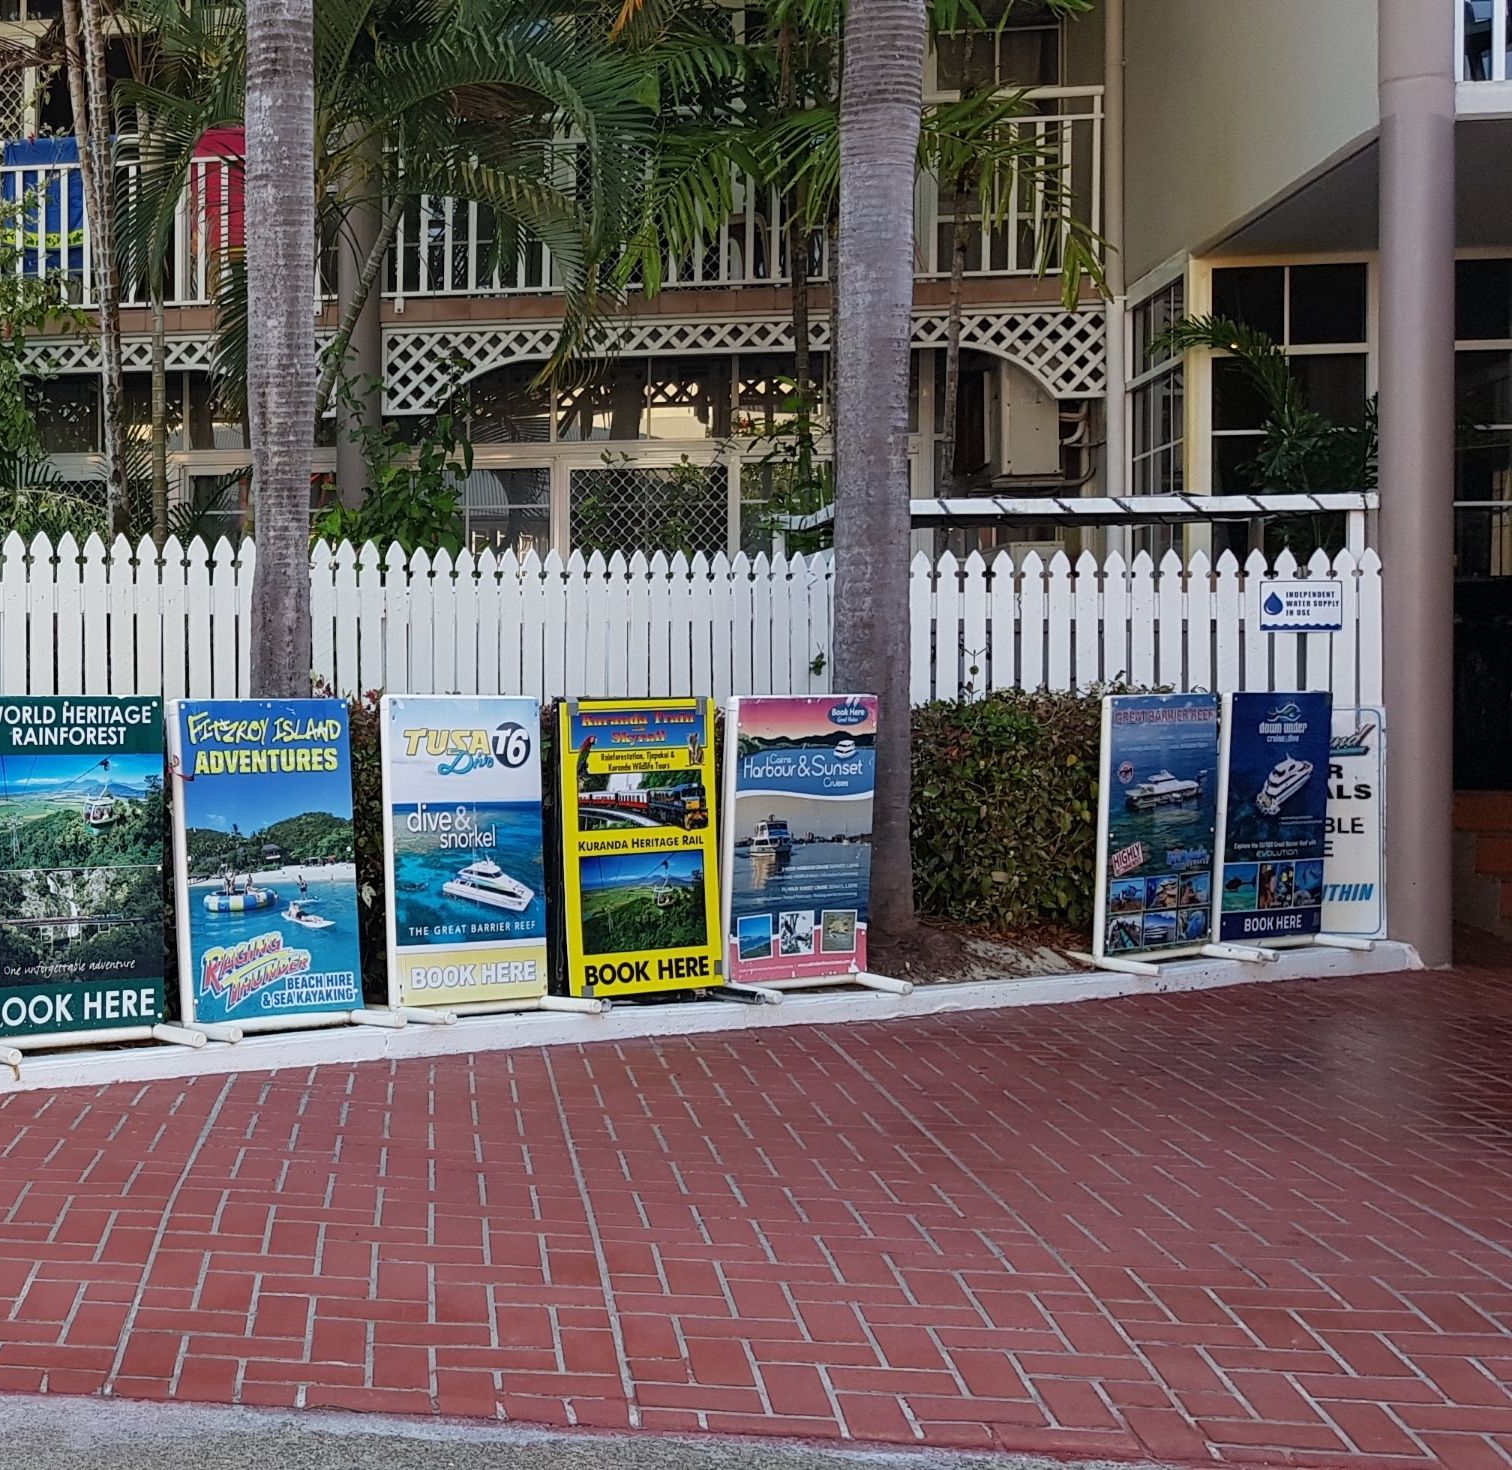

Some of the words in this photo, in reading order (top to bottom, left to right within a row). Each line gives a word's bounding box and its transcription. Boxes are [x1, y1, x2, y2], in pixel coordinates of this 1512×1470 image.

[62, 705, 152, 724] HERITAGE
[582, 713, 648, 727] Kuranda
[653, 711, 695, 724] Train
[1115, 711, 1145, 724] GREAT
[1149, 709, 1188, 722] BARRIER
[1191, 708, 1213, 721] REEF
[12, 727, 126, 746] RAINFOREST
[272, 717, 341, 743] ISLAND
[1259, 721, 1282, 734] down
[1284, 722, 1307, 734] under
[403, 728, 491, 756] TUSA
[491, 728, 529, 766] T6
[611, 730, 666, 746] Skyrail
[195, 748, 338, 775] ADVENTURES
[438, 748, 494, 776] Dive
[670, 751, 675, 759] &
[769, 754, 792, 764] Cairns
[608, 763, 631, 771] Kuranda
[632, 762, 654, 771] Wildlife
[655, 762, 670, 770] Tours
[744, 756, 796, 779] Harbour
[798, 755, 811, 777] &
[811, 754, 863, 776] Sunset
[823, 777, 849, 788] Cruises
[407, 803, 452, 832] dive
[454, 805, 472, 831] &
[440, 823, 496, 848] snorkel
[578, 838, 628, 852] KURANDA
[632, 836, 679, 849] HERITAGE
[682, 835, 704, 846] RAIL
[1114, 844, 1141, 869] HIGHLY
[1322, 883, 1374, 902] ITHIN
[409, 927, 429, 937] THE
[434, 924, 467, 935] GREAT
[471, 922, 511, 933] BARRIER
[514, 920, 536, 930] REEF
[1244, 917, 1274, 932] BOOK
[1276, 914, 1303, 929] HERE
[3, 964, 21, 976] One
[24, 960, 86, 978] unforgettable
[89, 959, 136, 971] adventure
[203, 933, 282, 993] RAGING
[584, 961, 650, 987] BOOK
[658, 955, 709, 980] HERE
[220, 949, 309, 1008] THUNDER
[288, 975, 324, 990] BEACH
[326, 973, 353, 987] HIRE
[411, 963, 476, 989] BOOK
[481, 960, 537, 985] HERE
[84, 988, 155, 1019] HERE
[262, 993, 272, 1006] &
[273, 992, 294, 1005] SEA
[296, 988, 354, 1003] KAYAKING
